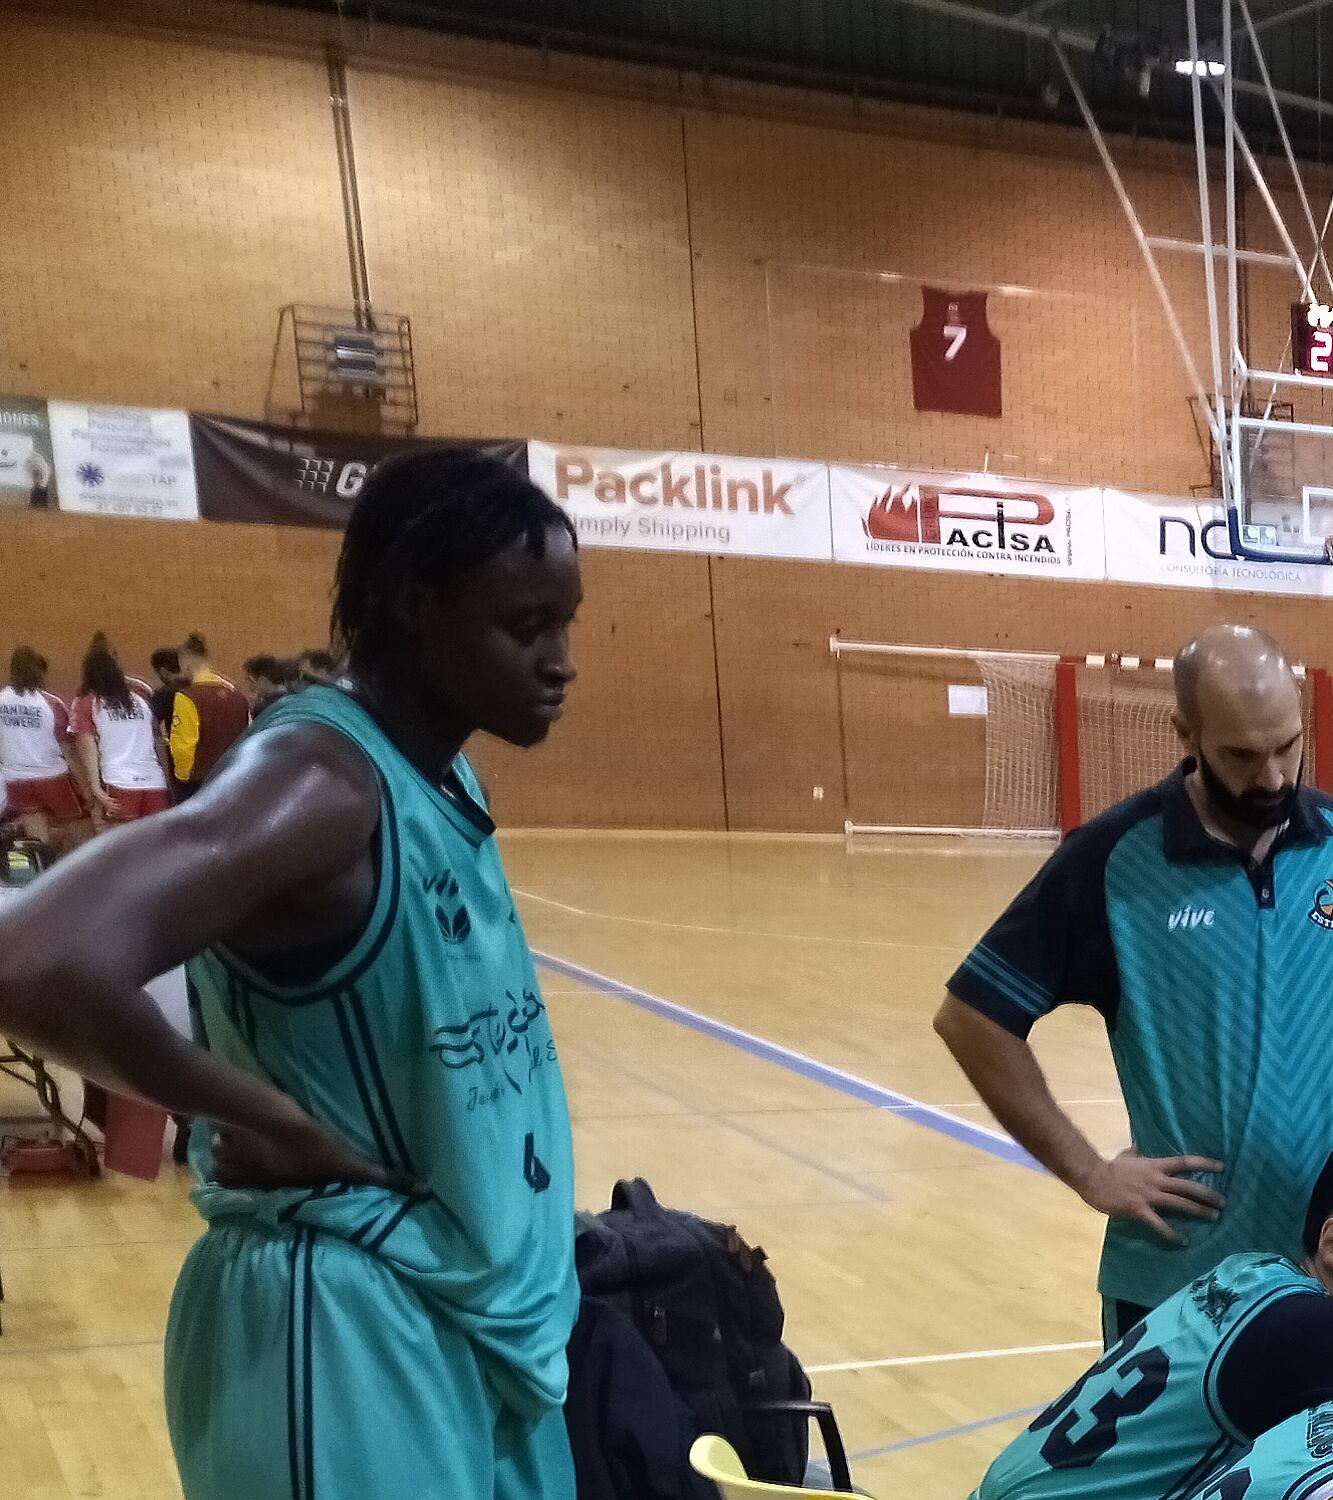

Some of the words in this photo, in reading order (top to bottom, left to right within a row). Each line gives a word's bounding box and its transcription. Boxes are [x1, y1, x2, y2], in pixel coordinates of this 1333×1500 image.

[943, 325, 967, 361] 7
[555, 454, 795, 515] Packlink
[573, 517, 631, 536] imply
[638, 519, 730, 543] Shipping
[977, 551, 1012, 561] CONTRA
[1014, 555, 1061, 565] INCENDIOS
